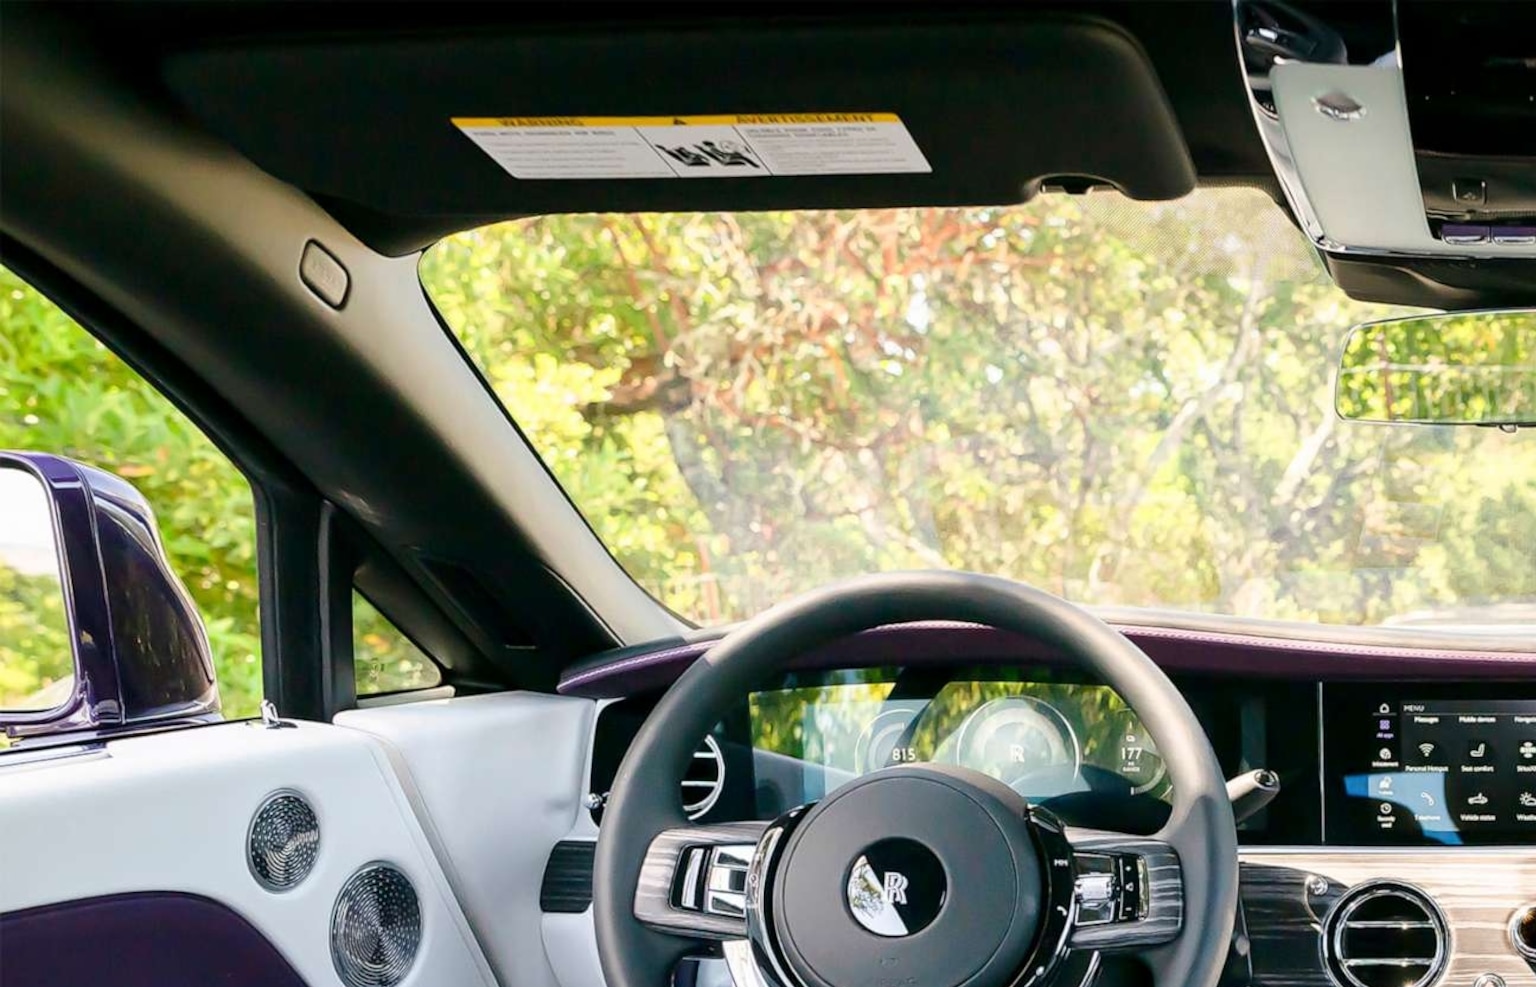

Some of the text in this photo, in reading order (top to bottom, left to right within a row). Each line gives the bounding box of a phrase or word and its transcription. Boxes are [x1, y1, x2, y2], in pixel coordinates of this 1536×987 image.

[498, 117, 584, 127] WARNING
[736, 114, 875, 124] AVERTISSEMENT
[1403, 704, 1425, 712] MENU
[892, 748, 917, 762] 815
[1122, 747, 1142, 760] 177
